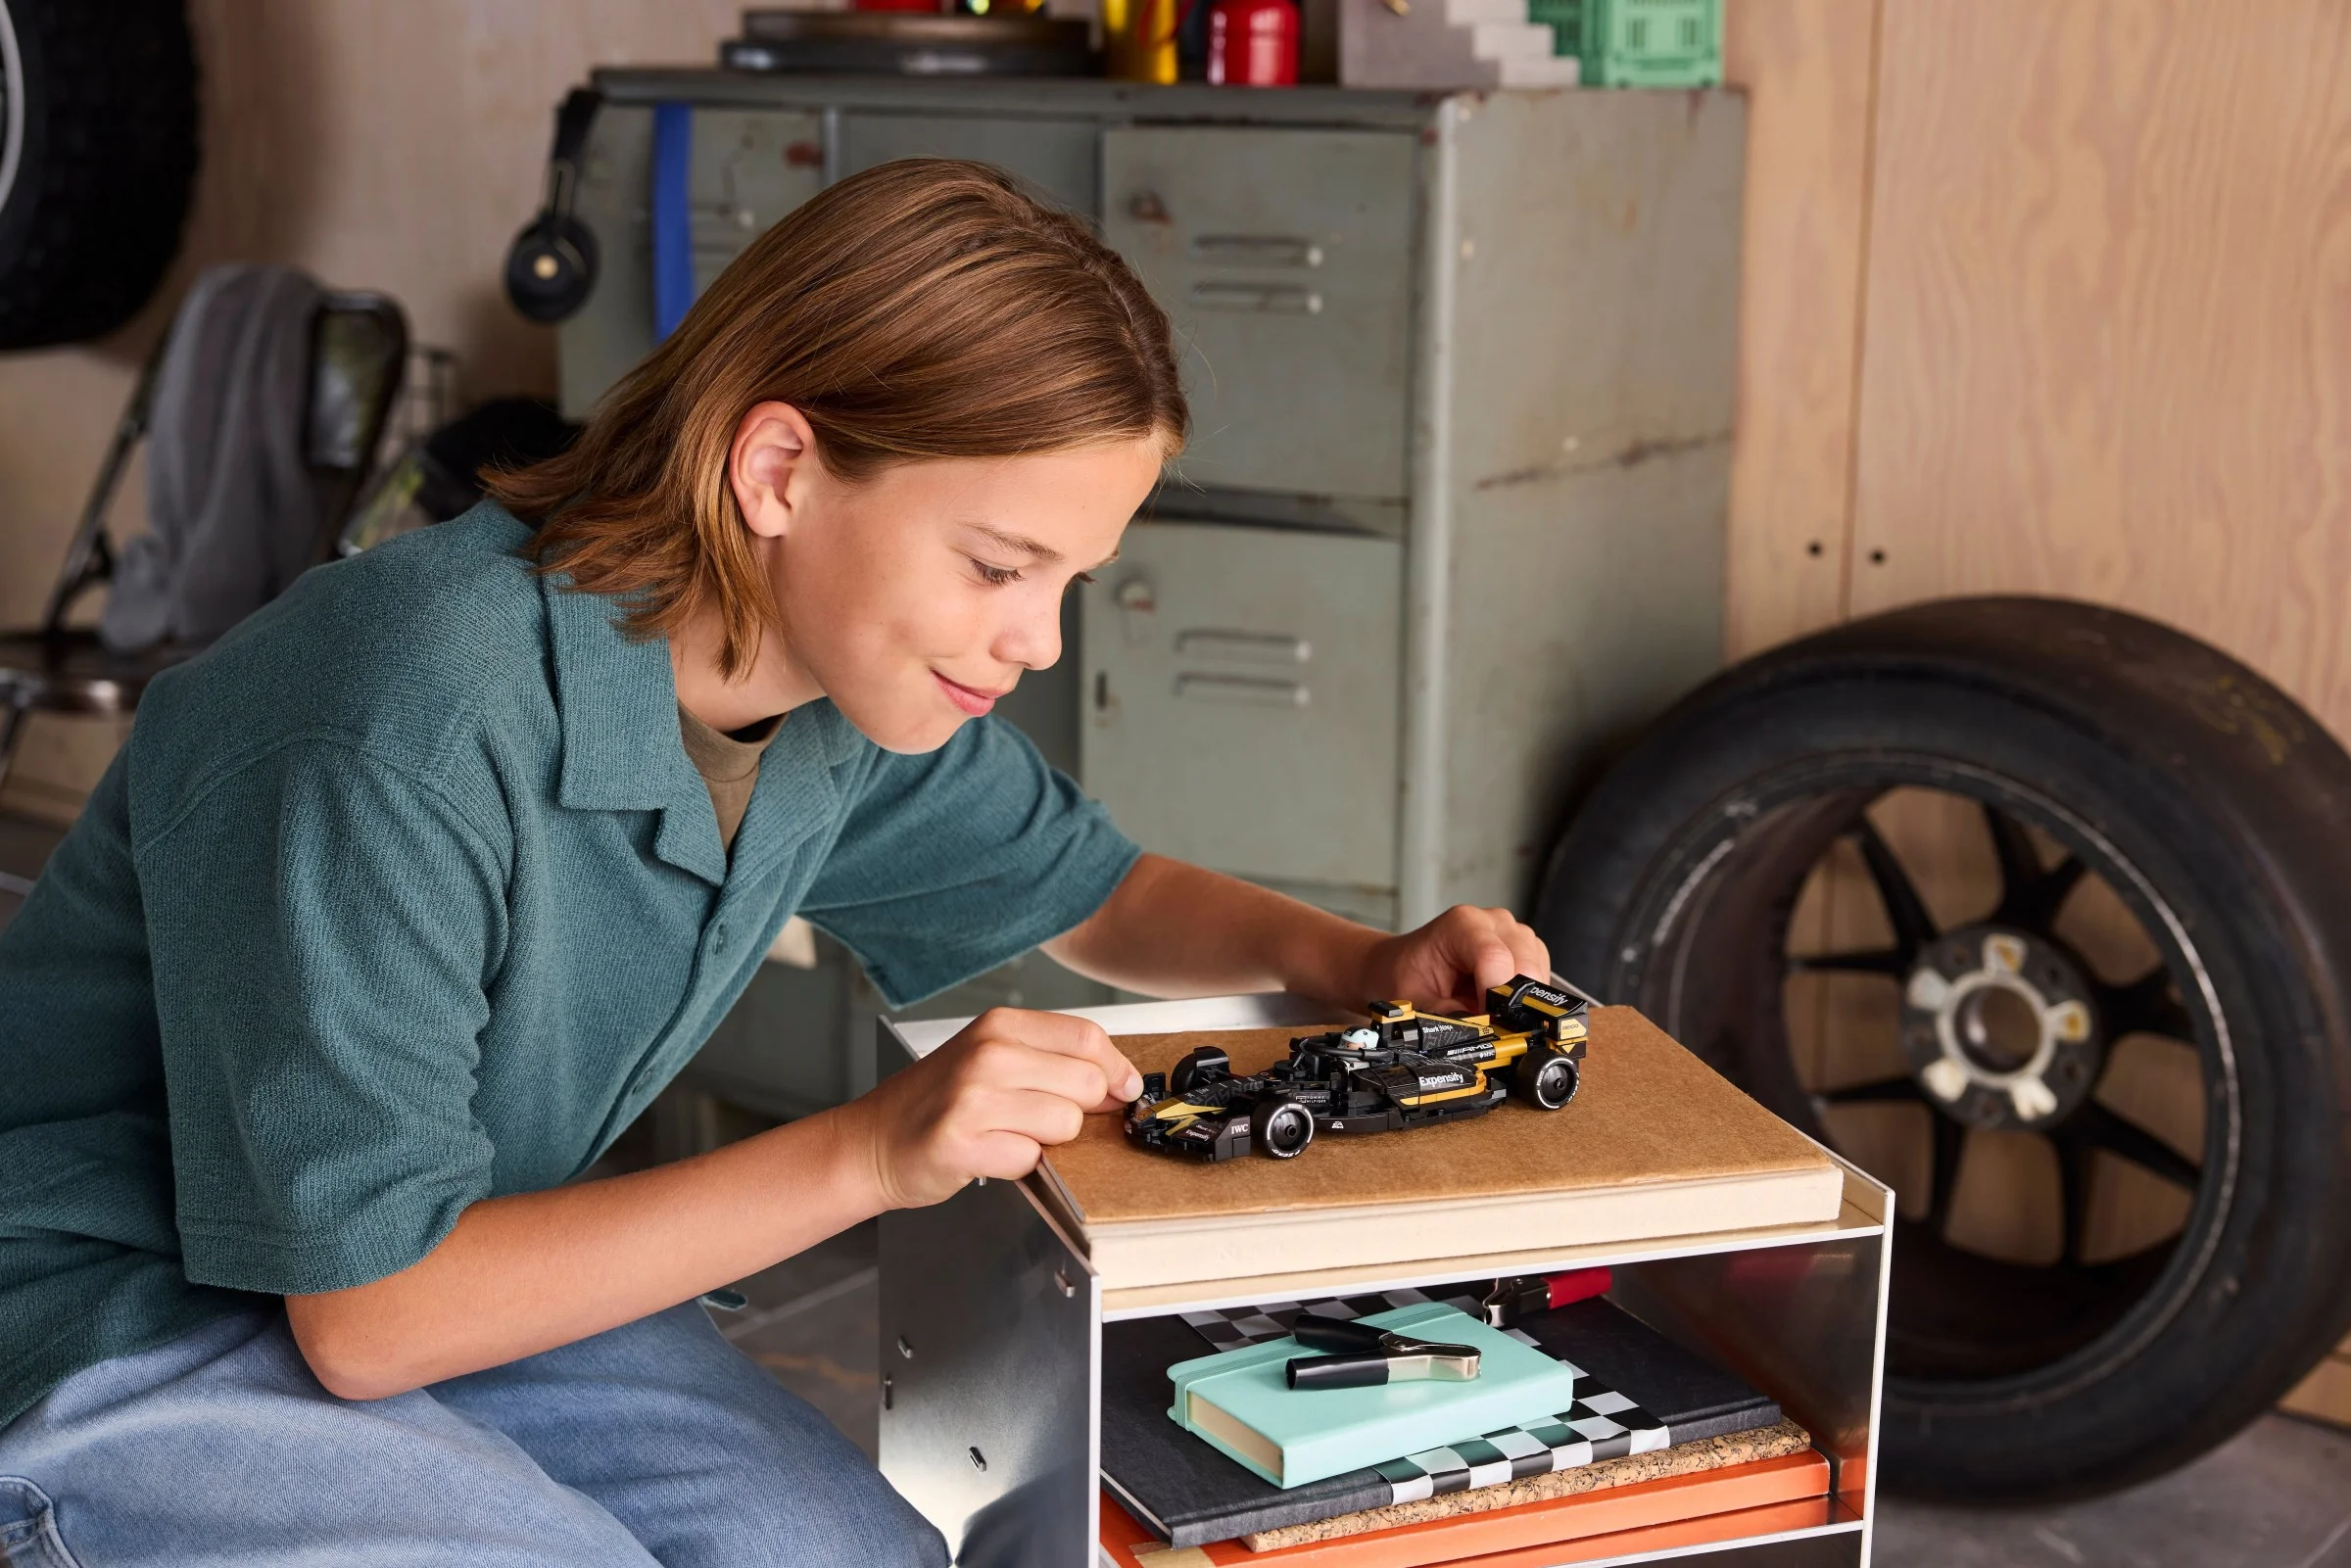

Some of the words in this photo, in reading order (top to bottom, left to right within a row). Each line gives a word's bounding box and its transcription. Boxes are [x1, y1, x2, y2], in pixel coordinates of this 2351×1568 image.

[1529, 986, 1568, 1007] pensify
[1418, 1072, 1463, 1088] Expensify
[1231, 1123, 1249, 1135] IWC
